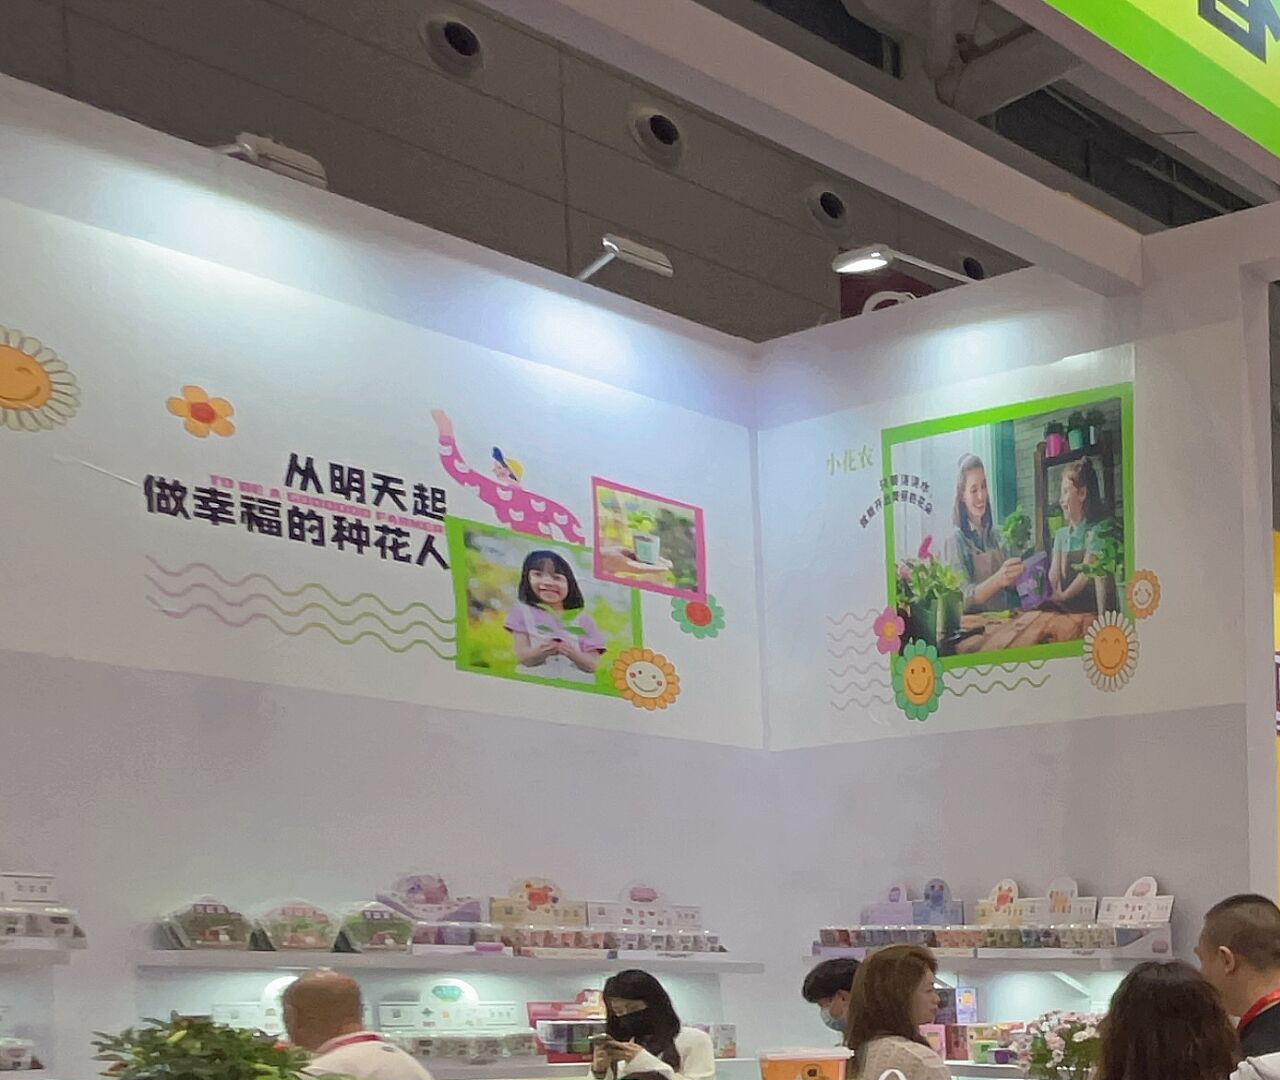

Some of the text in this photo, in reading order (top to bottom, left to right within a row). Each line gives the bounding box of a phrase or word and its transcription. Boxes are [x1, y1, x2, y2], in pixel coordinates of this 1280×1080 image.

[143, 474, 451, 570] 做幸福的种花人
[284, 452, 449, 522] 从明天起
